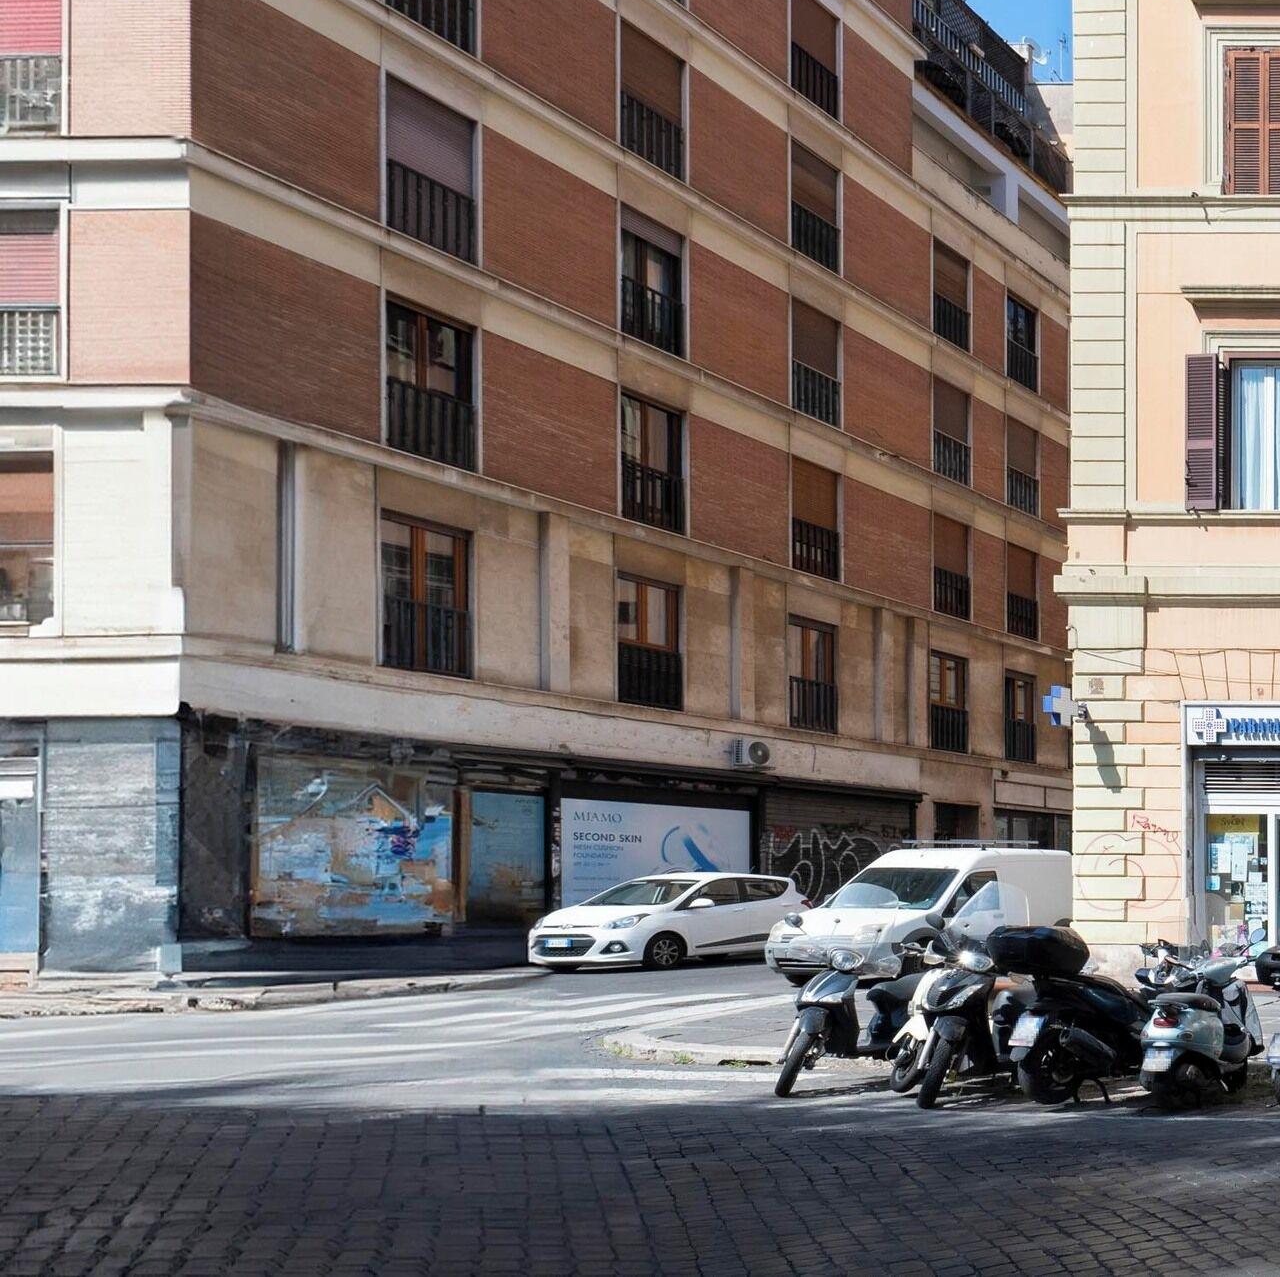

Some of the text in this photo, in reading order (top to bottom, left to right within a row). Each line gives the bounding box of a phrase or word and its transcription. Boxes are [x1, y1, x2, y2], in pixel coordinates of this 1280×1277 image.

[573, 811, 622, 824] MIAMO
[573, 832, 642, 843] SECOND SKIN
[573, 852, 618, 860] FOUNDATION
